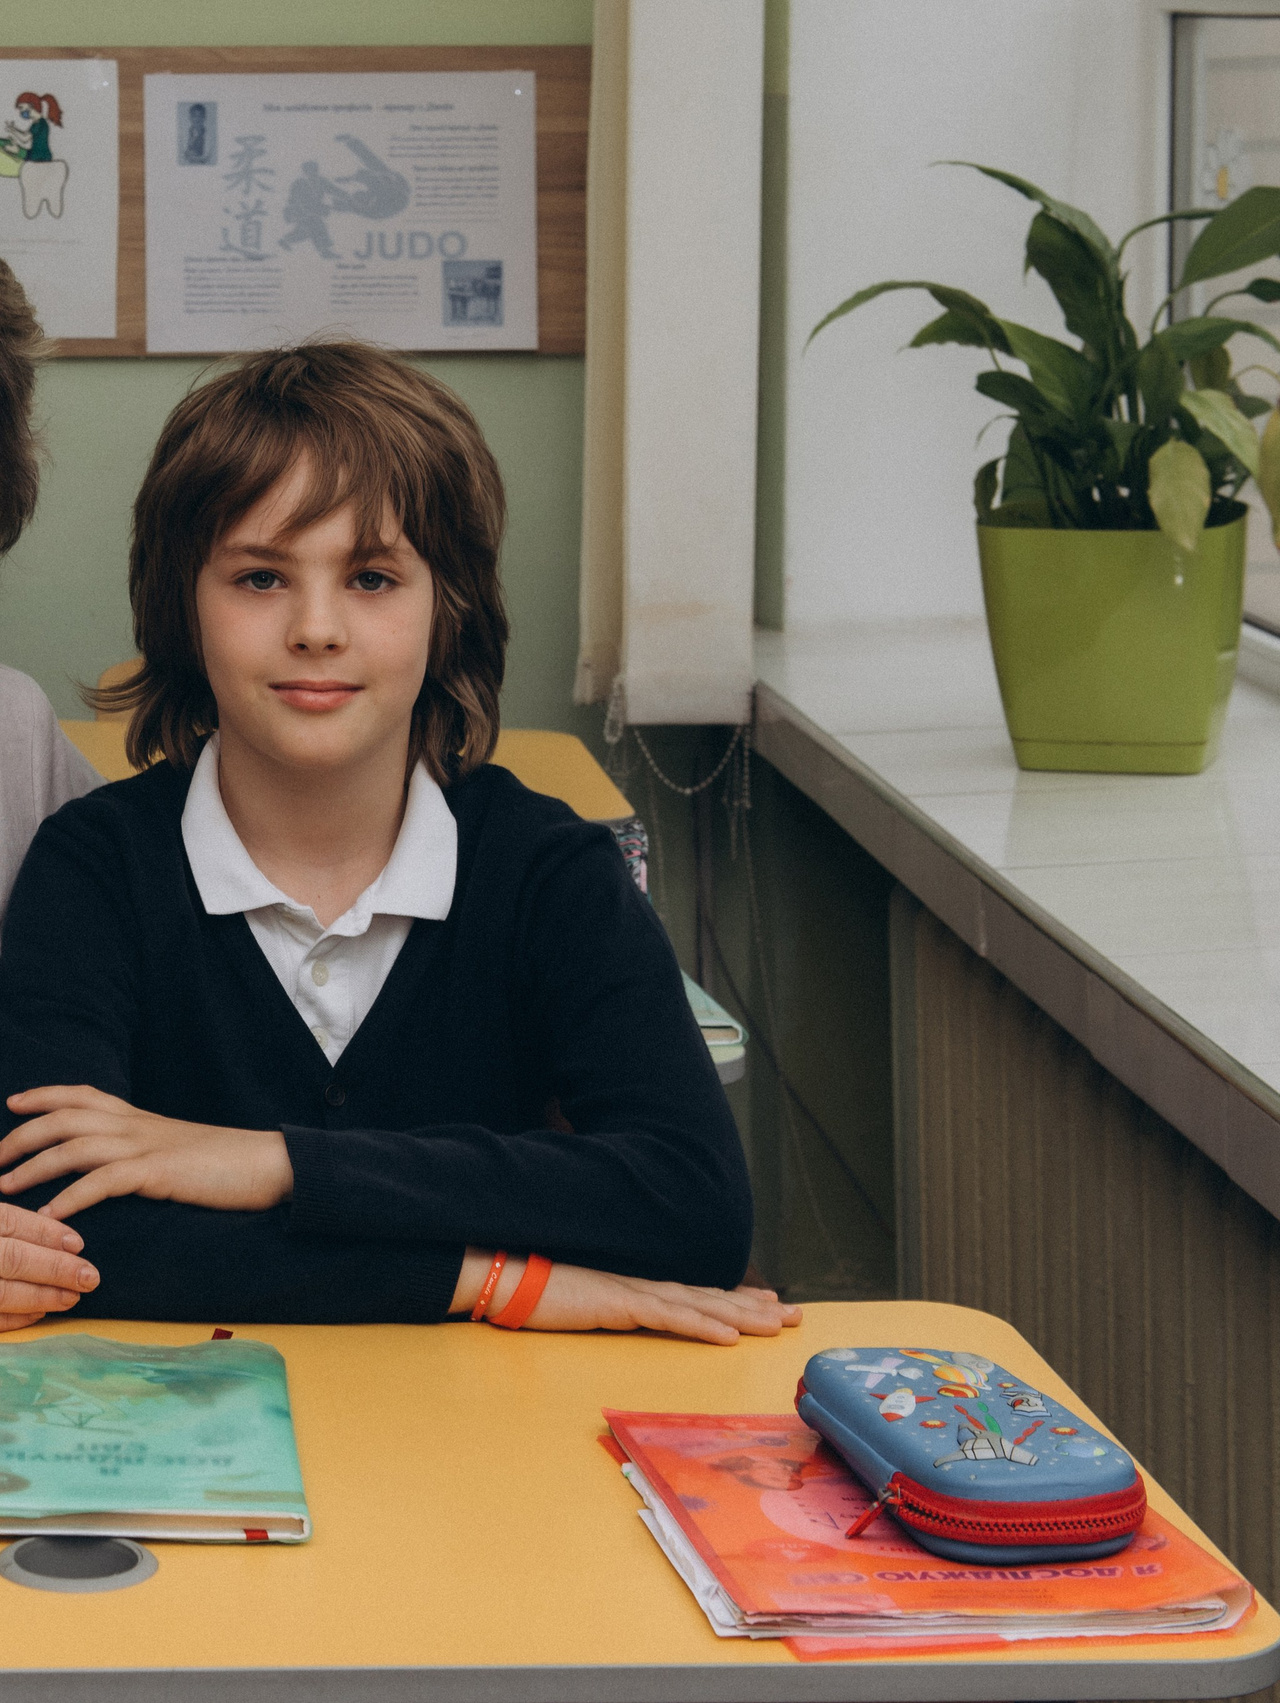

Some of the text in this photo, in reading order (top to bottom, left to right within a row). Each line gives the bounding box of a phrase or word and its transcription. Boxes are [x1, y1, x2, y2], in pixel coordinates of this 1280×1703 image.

[353, 231, 469, 260] JUDO
[875, 1567, 1120, 1582] ДОСЛІДЖУЮ
[1133, 1564, 1158, 1577] Я
